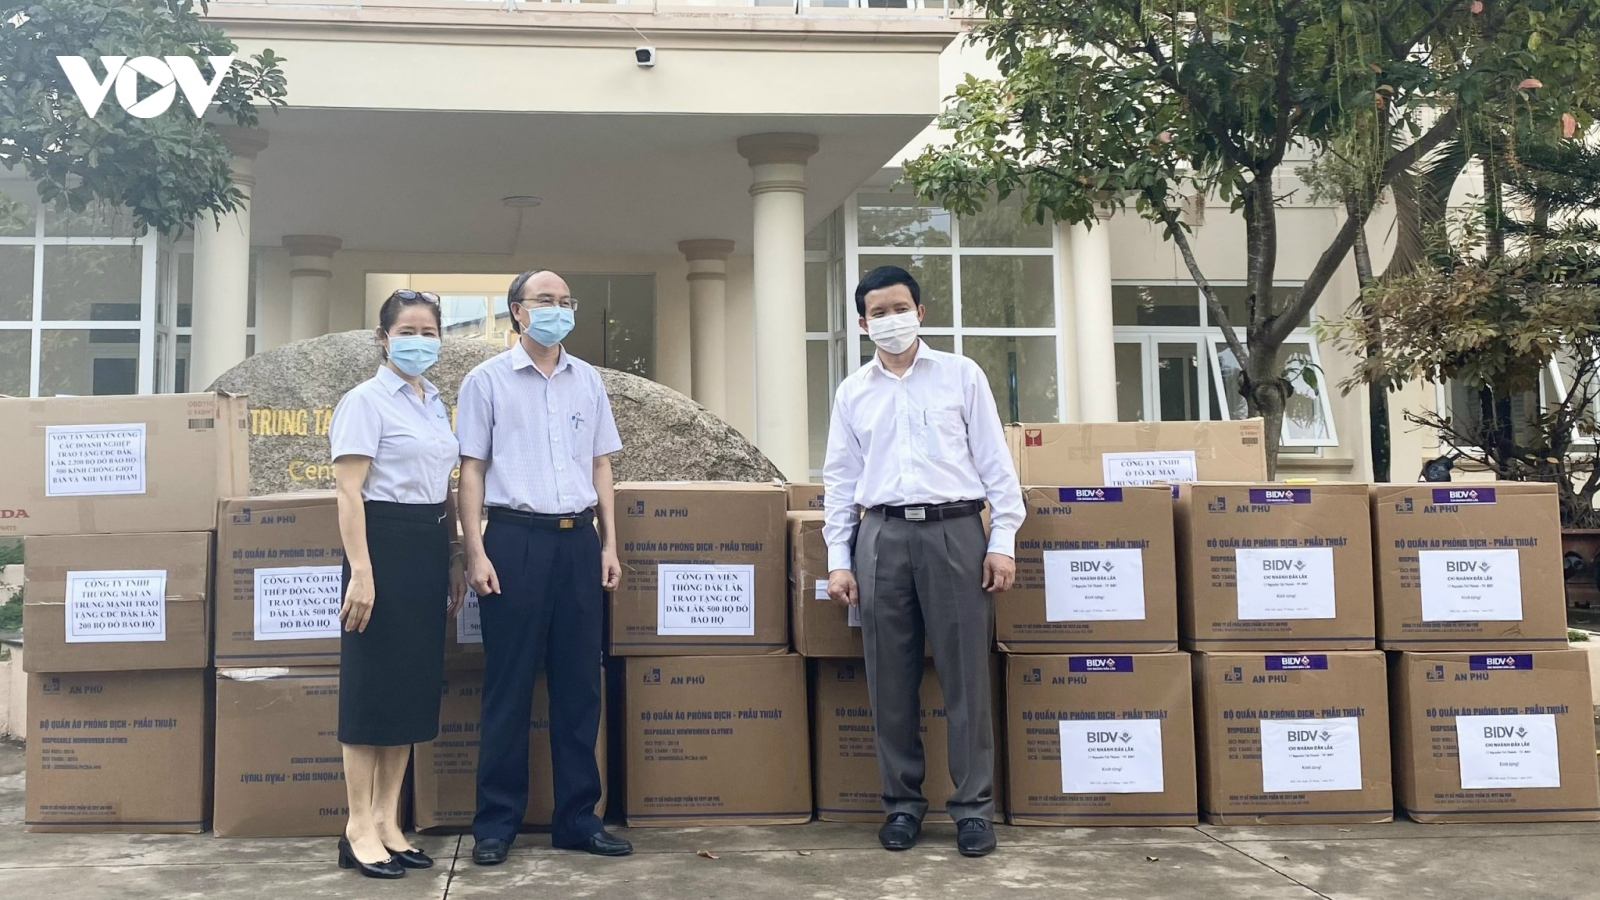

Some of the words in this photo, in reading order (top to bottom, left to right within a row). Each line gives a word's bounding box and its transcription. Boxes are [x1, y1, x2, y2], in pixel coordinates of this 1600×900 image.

[250, 409, 308, 435] TRUNG
[313, 404, 332, 435] TÂ
[1121, 459, 1143, 467] CÔNG
[670, 509, 688, 517] PHÚ
[1053, 505, 1071, 514] PHÚ
[261, 516, 274, 524] AN
[277, 514, 296, 523] PHÚ
[1071, 561, 1101, 572] BIDV
[1263, 560, 1292, 570] BIDV
[1447, 561, 1477, 572] BIDV
[264, 576, 290, 584] CÔNG
[676, 572, 701, 580] CÔNG
[85, 579, 109, 587] CÔNG
[672, 583, 702, 591] THÔNG
[107, 601, 132, 609] MẠNH
[317, 620, 330, 628] HỘ
[1087, 659, 1106, 667] BIDV
[687, 675, 705, 684] PHÚ
[1068, 675, 1087, 684] PHÚ
[1268, 674, 1287, 683] PHÚ
[1455, 673, 1467, 681] AN
[1470, 672, 1489, 680] PHÚ
[69, 686, 82, 694] AN
[85, 684, 103, 694] PHÚ
[1288, 731, 1317, 741] BIDV
[1484, 727, 1513, 738] BIDV
[1087, 732, 1118, 743] BIDV
